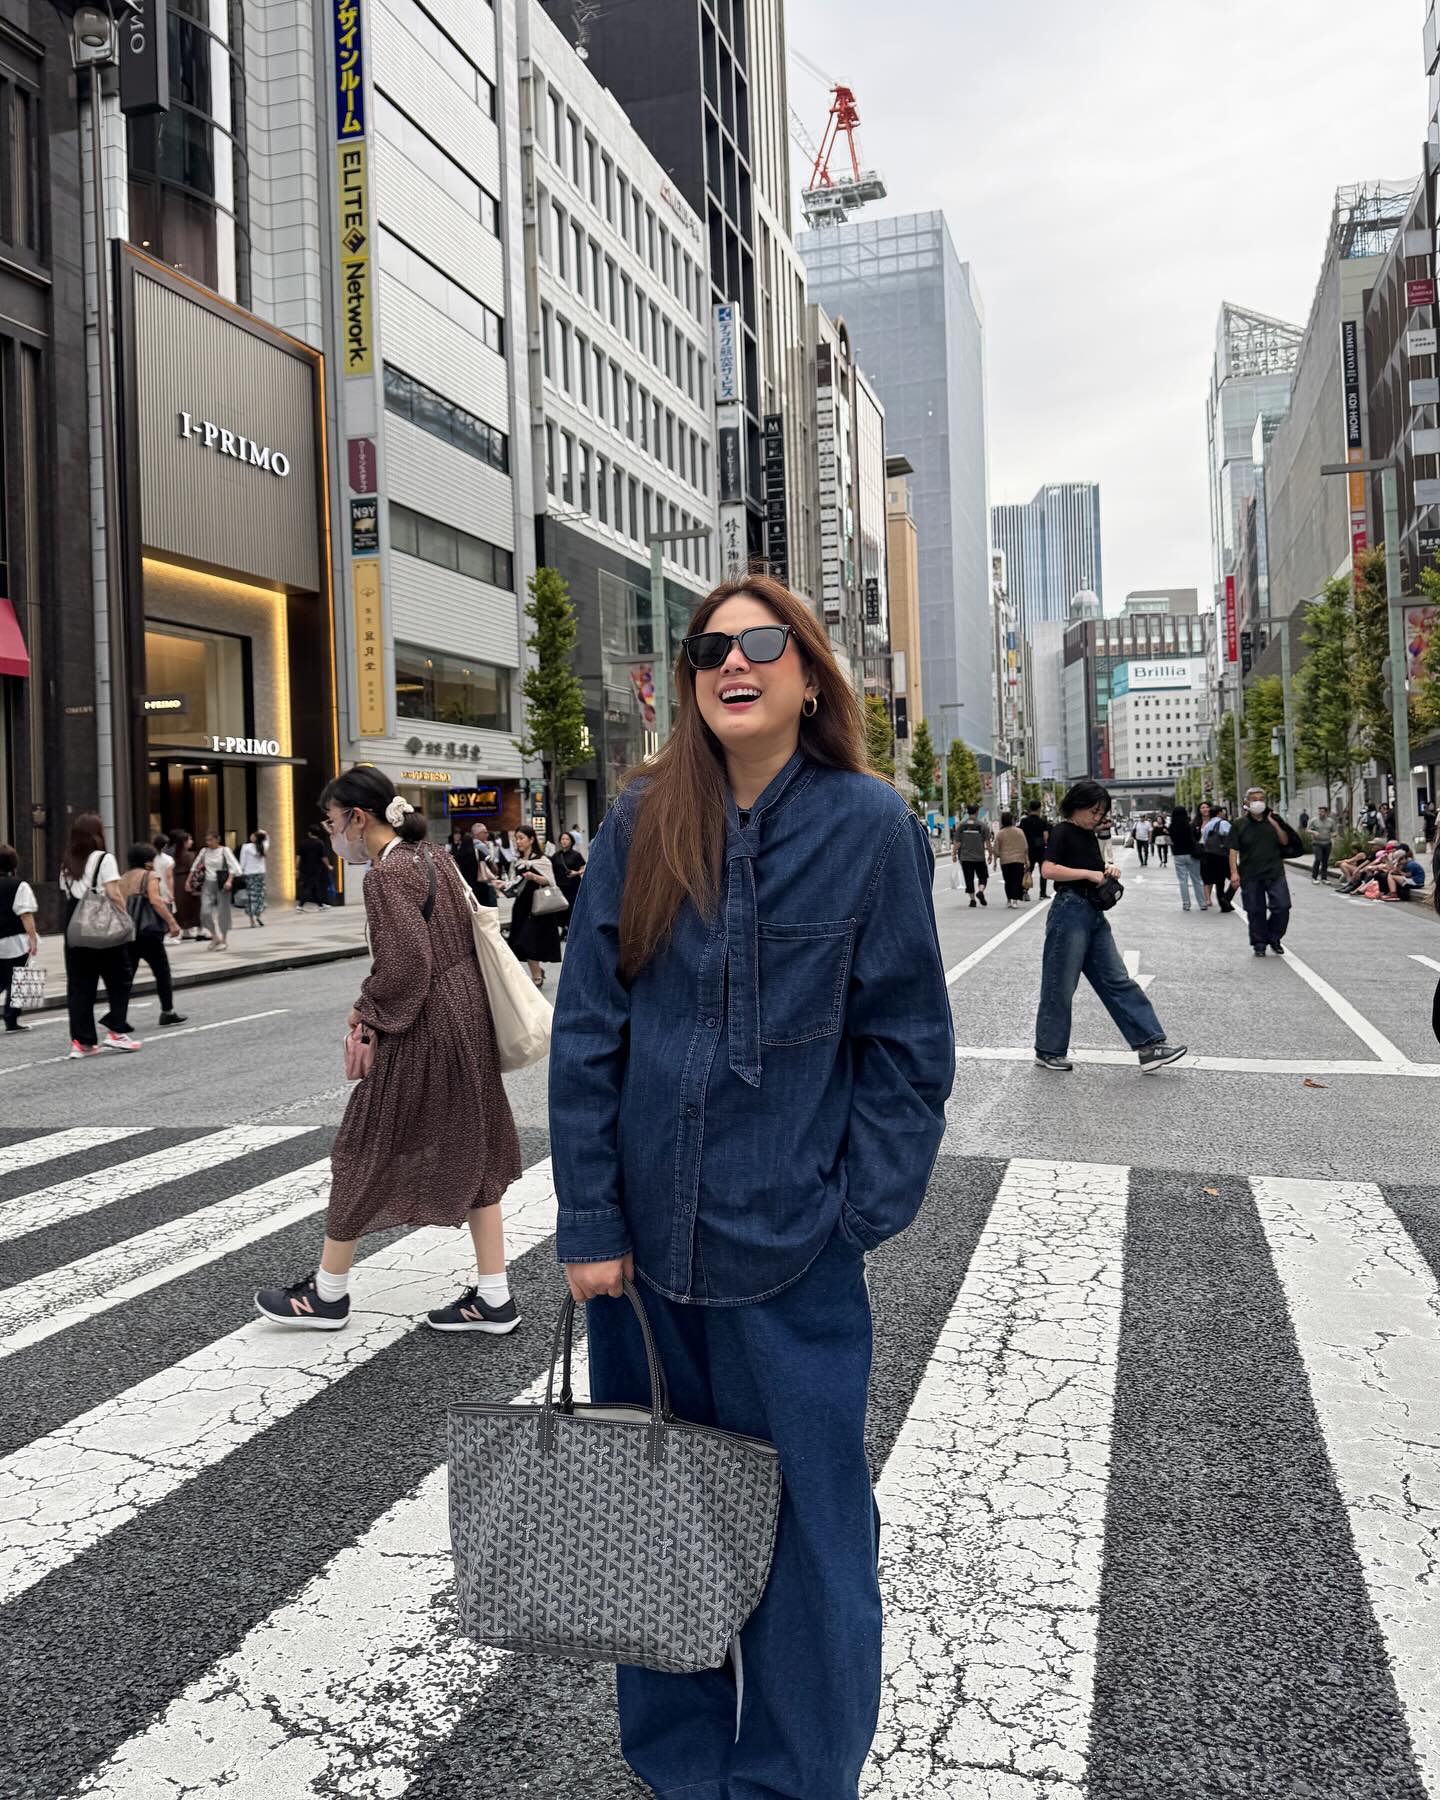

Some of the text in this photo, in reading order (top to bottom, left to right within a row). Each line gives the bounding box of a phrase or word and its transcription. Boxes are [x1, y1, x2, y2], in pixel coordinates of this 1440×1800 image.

[342, 150, 363, 229] ELITE
[180, 411, 290, 477] I-PRIMO
[352, 506, 376, 519] N9Y
[1134, 666, 1186, 678] Brillia
[144, 699, 182, 710] I-PRIMO
[211, 735, 280, 756] I-PRIMO
[448, 793, 477, 808] N9Y
